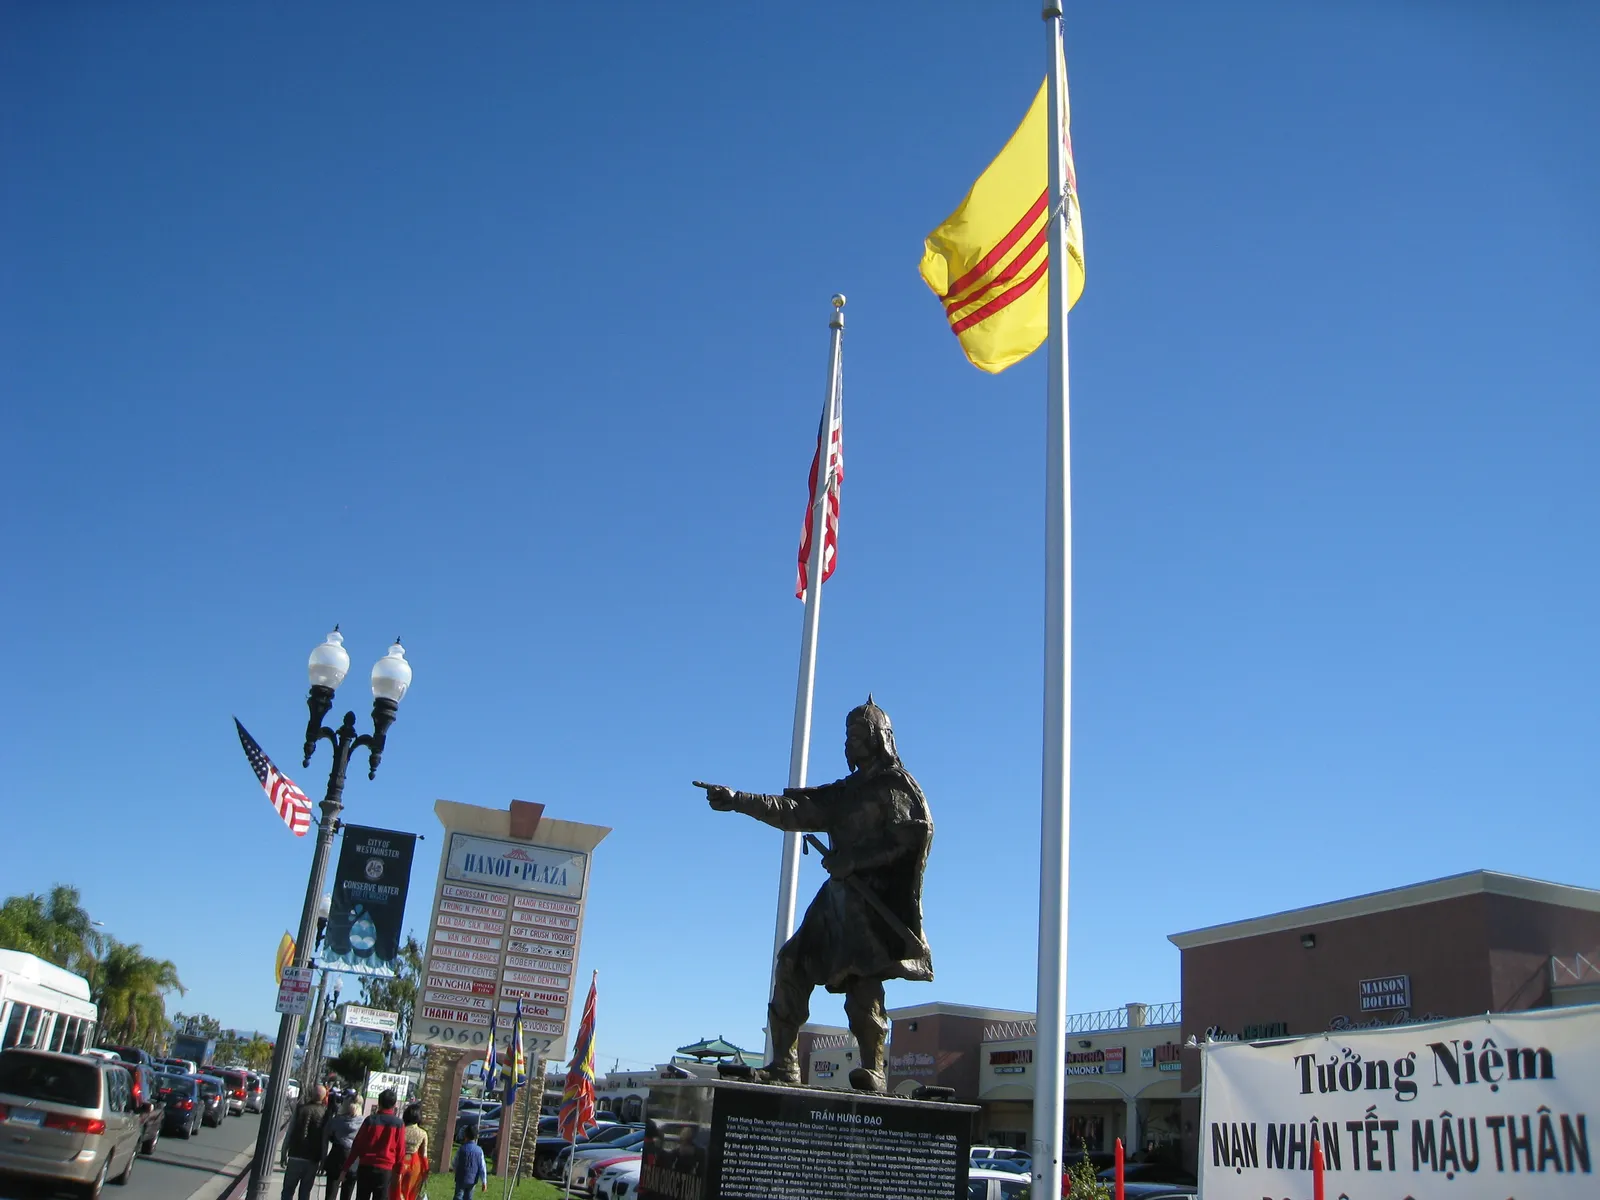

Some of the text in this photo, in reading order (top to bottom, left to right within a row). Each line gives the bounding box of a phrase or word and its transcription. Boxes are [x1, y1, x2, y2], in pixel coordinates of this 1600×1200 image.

[368, 838, 382, 846] CITY
[356, 844, 400, 858] WESTMINSTER
[464, 853, 567, 886] HANOI PLAZA
[344, 880, 376, 892] CONSERVE
[378, 886, 400, 896] WATER
[456, 889, 488, 900] CROISSANT
[517, 897, 576, 913] HANOI RESTAURANT
[513, 927, 573, 942] SOFT CRUSH YOGURT
[472, 952, 496, 962] FABRICS
[510, 957, 567, 971] ROBERT MULLINS
[447, 964, 471, 973] BEAUTY
[472, 967, 496, 977] CENTER
[513, 973, 560, 986] SAIGON DENTAL
[1362, 978, 1404, 994] MAISON
[432, 993, 486, 1008] SAIGON TEL
[1363, 993, 1405, 1009] BOUTIK
[424, 1007, 453, 1020] THANH
[521, 1005, 549, 1016] ricket
[1206, 1024, 1240, 1042] Saigon
[1293, 1038, 1556, 1102] Tưởng Niệm
[1212, 1105, 1591, 1180] NẠN NHÂN TẾT MẬU THÂN
